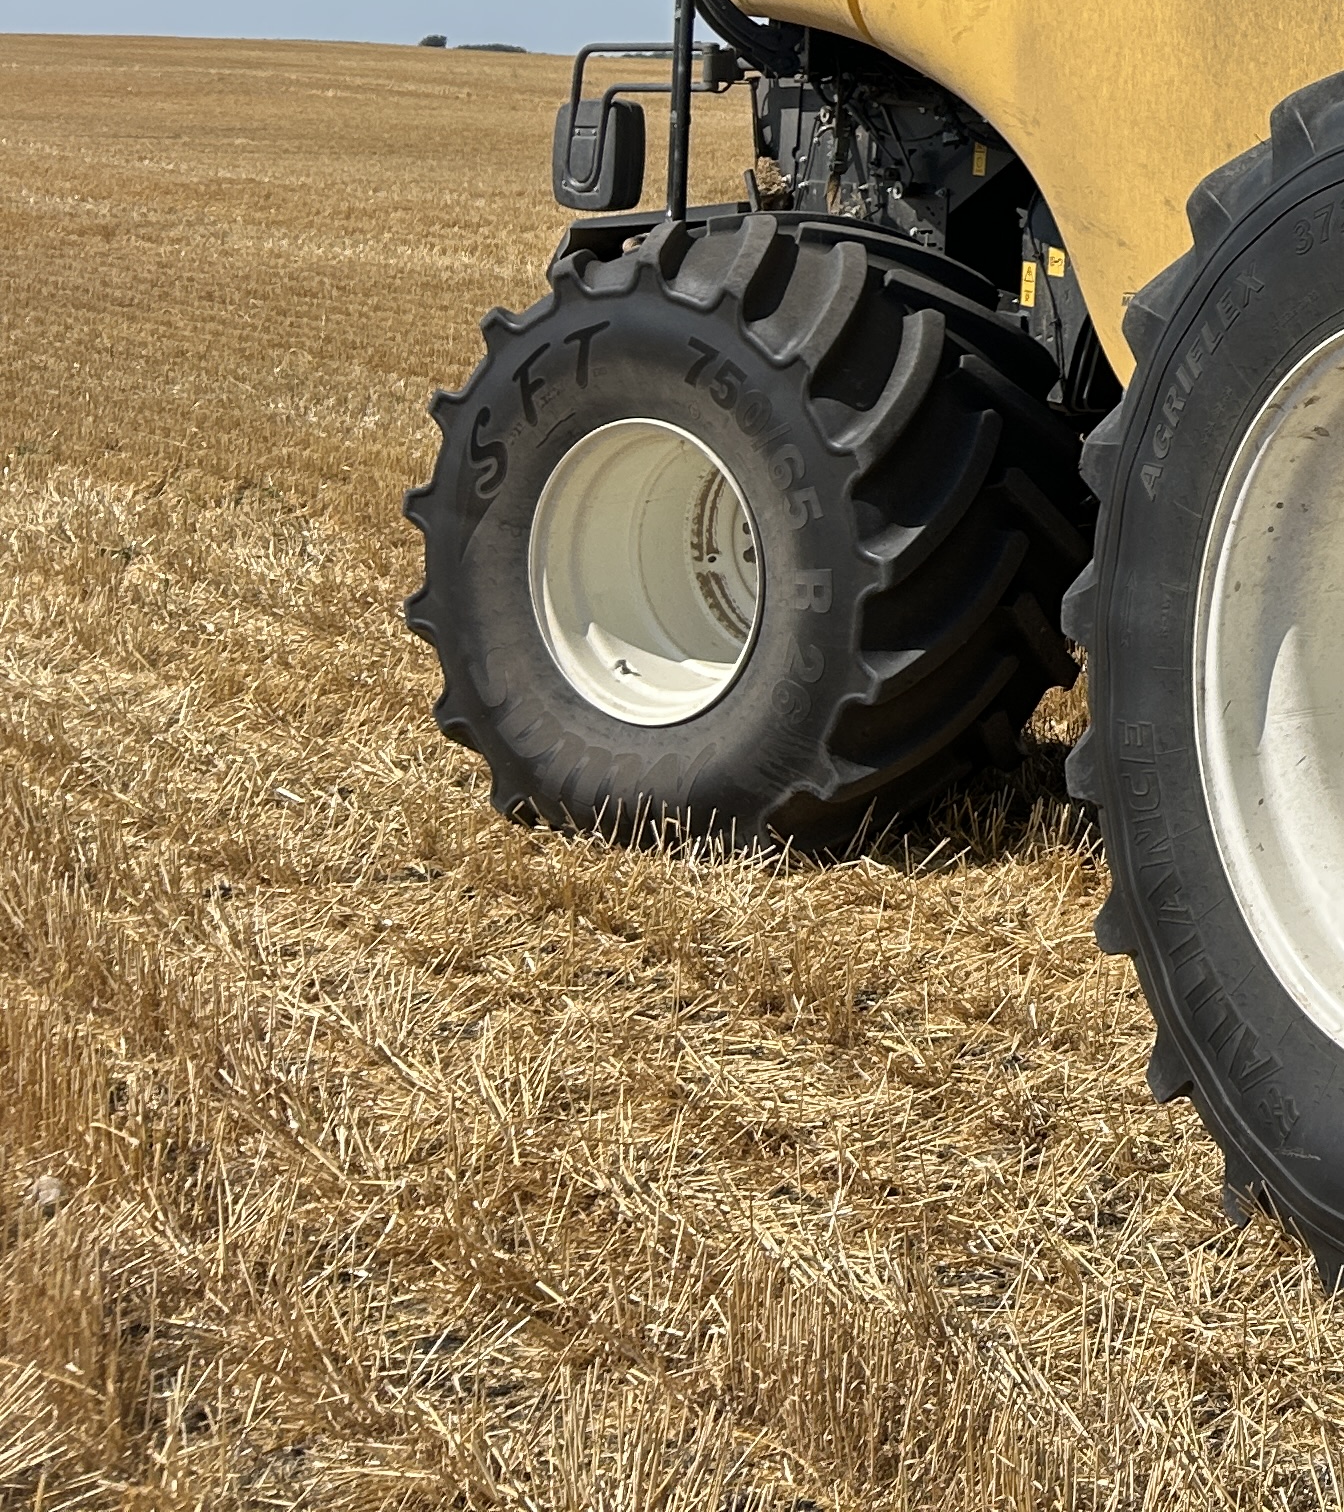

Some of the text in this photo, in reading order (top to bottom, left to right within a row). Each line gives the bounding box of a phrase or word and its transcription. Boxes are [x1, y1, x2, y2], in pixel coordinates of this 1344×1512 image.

[684, 336, 824, 532] 750/65
[770, 633, 825, 726] 26
[1139, 261, 1265, 501] AGRIFLEX
[1117, 719, 1283, 1080] ALLIANCE
